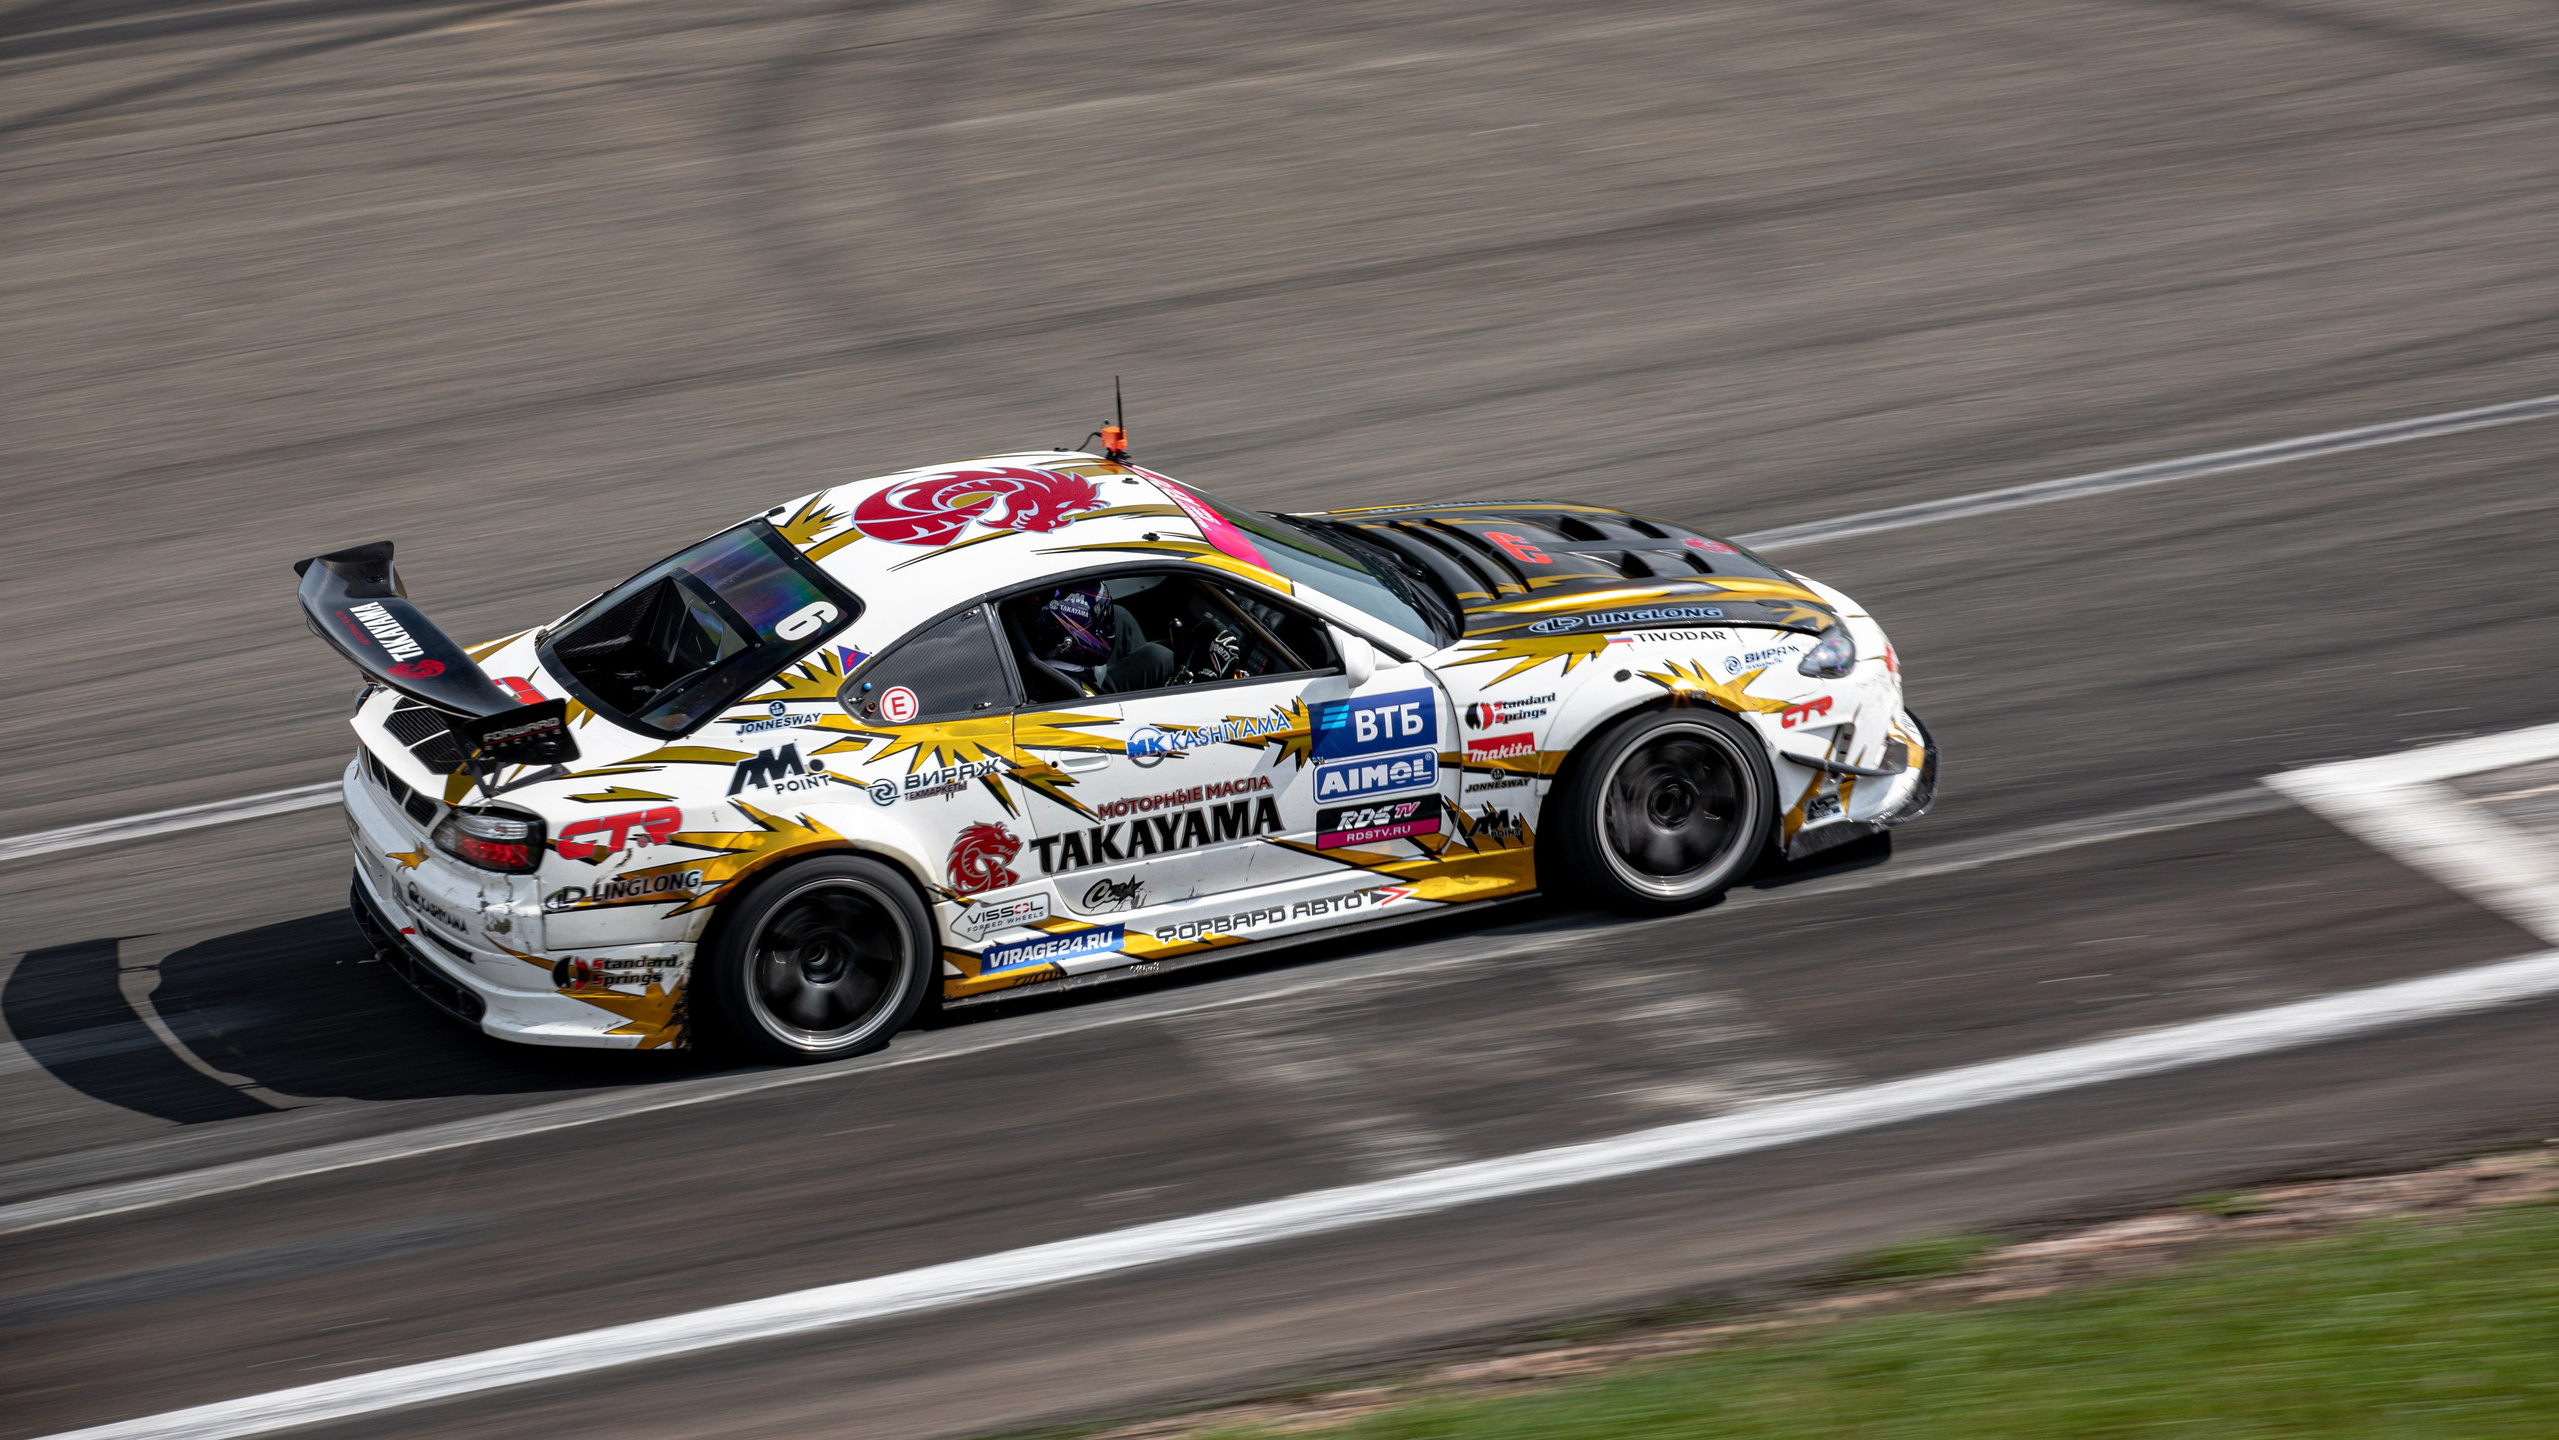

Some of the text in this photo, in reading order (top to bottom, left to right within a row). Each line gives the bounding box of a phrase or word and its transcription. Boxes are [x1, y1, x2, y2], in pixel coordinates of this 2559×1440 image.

[775, 602, 838, 641] 6
[1060, 604, 1089, 618] TAKAYAMA
[1587, 607, 1724, 627] LINGLONG
[349, 602, 424, 662] TAKAYAMA
[1634, 630, 1727, 643] TIVODAR
[891, 697, 908, 716] E
[1494, 693, 1556, 711] Standard
[737, 712, 822, 736] JONNESWAY
[1354, 702, 1424, 743] ВТБ
[1495, 707, 1547, 724] Springs
[483, 717, 560, 742] FORWARD
[1127, 713, 1292, 759] MK KASHIYAMA
[1469, 743, 1536, 763] makita
[904, 758, 1000, 789] ВИРАЖ
[1320, 759, 1432, 796] AIMOL
[775, 775, 831, 795] POINT
[904, 781, 968, 800] ТЕХМАРКЕТЫ
[1465, 777, 1532, 794] JONNESWAY
[1098, 775, 1273, 820] МОТОРНЫЕ МАСЛА
[1336, 801, 1421, 831] RDS TV
[1029, 797, 1285, 875] TAKAYAMA
[1346, 825, 1411, 842] RDSTV.RU
[1491, 828, 1522, 838] POINT
[592, 869, 703, 903] LINGLONG
[967, 902, 1044, 924] VISSOL
[967, 911, 1044, 933] FORGED WHEELS
[1155, 895, 1363, 943] ФОРВАРД АВТО
[989, 931, 1113, 969] VIRAGE24.RU
[592, 956, 678, 971] Standard
[592, 973, 663, 987] Springs
